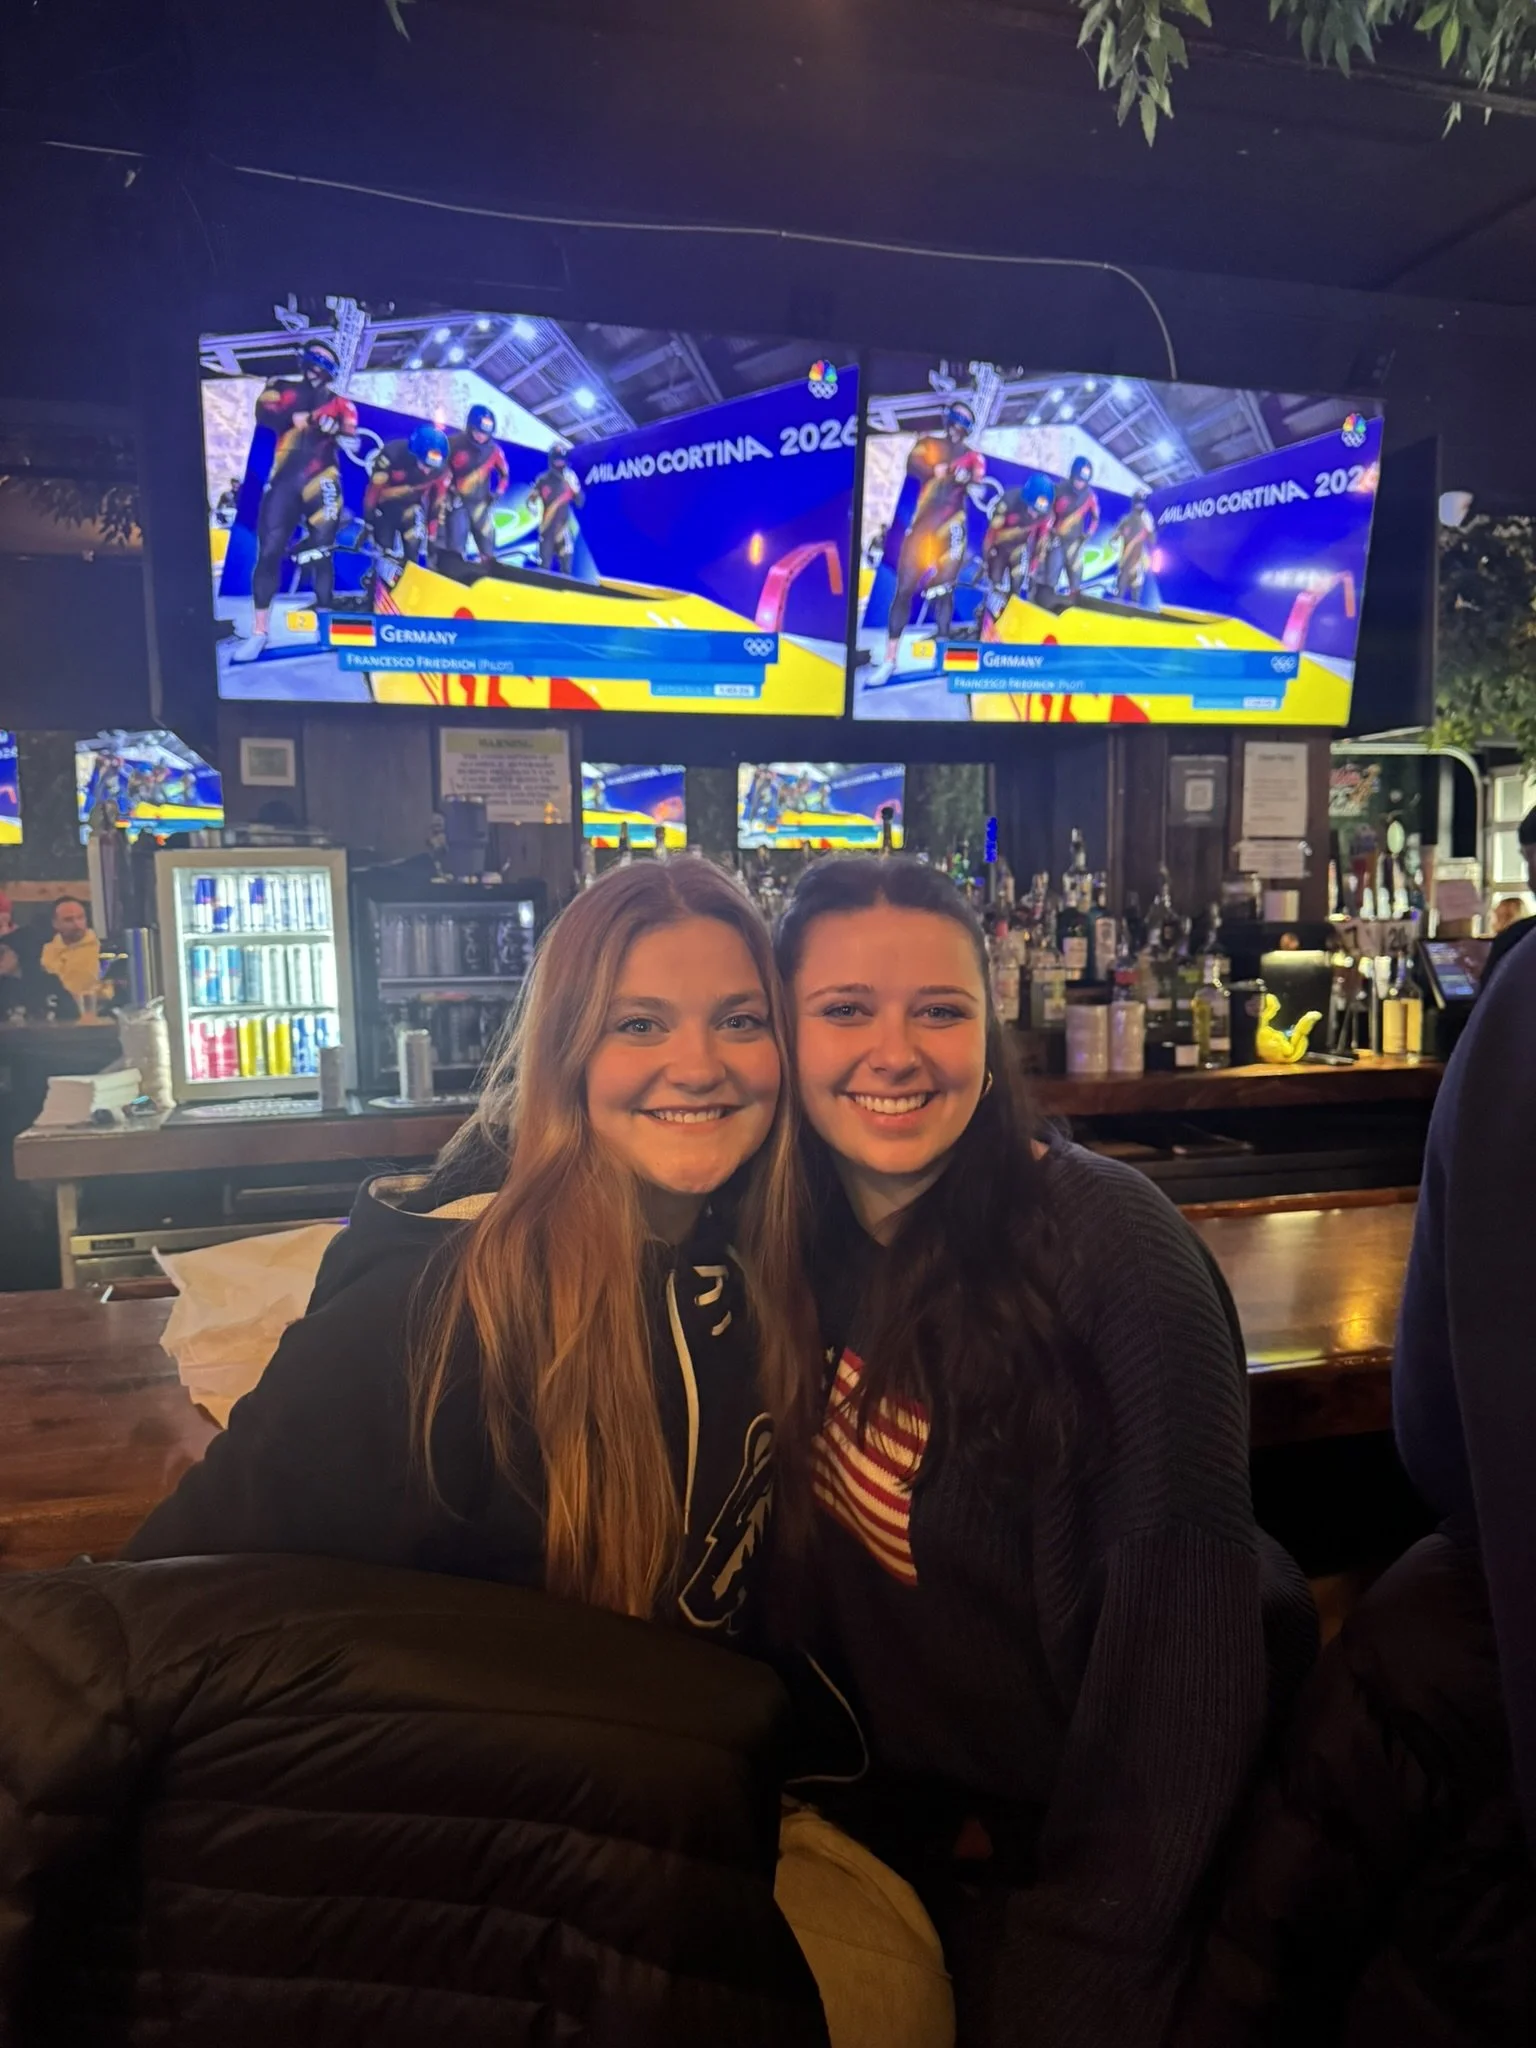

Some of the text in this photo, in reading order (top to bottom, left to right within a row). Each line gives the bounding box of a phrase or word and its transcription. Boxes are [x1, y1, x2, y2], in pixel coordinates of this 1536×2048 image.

[585, 454, 656, 485] MILANO
[656, 435, 774, 475] CORTINA
[1157, 497, 1214, 525] MILANO
[1216, 480, 1311, 514] CORTINA
